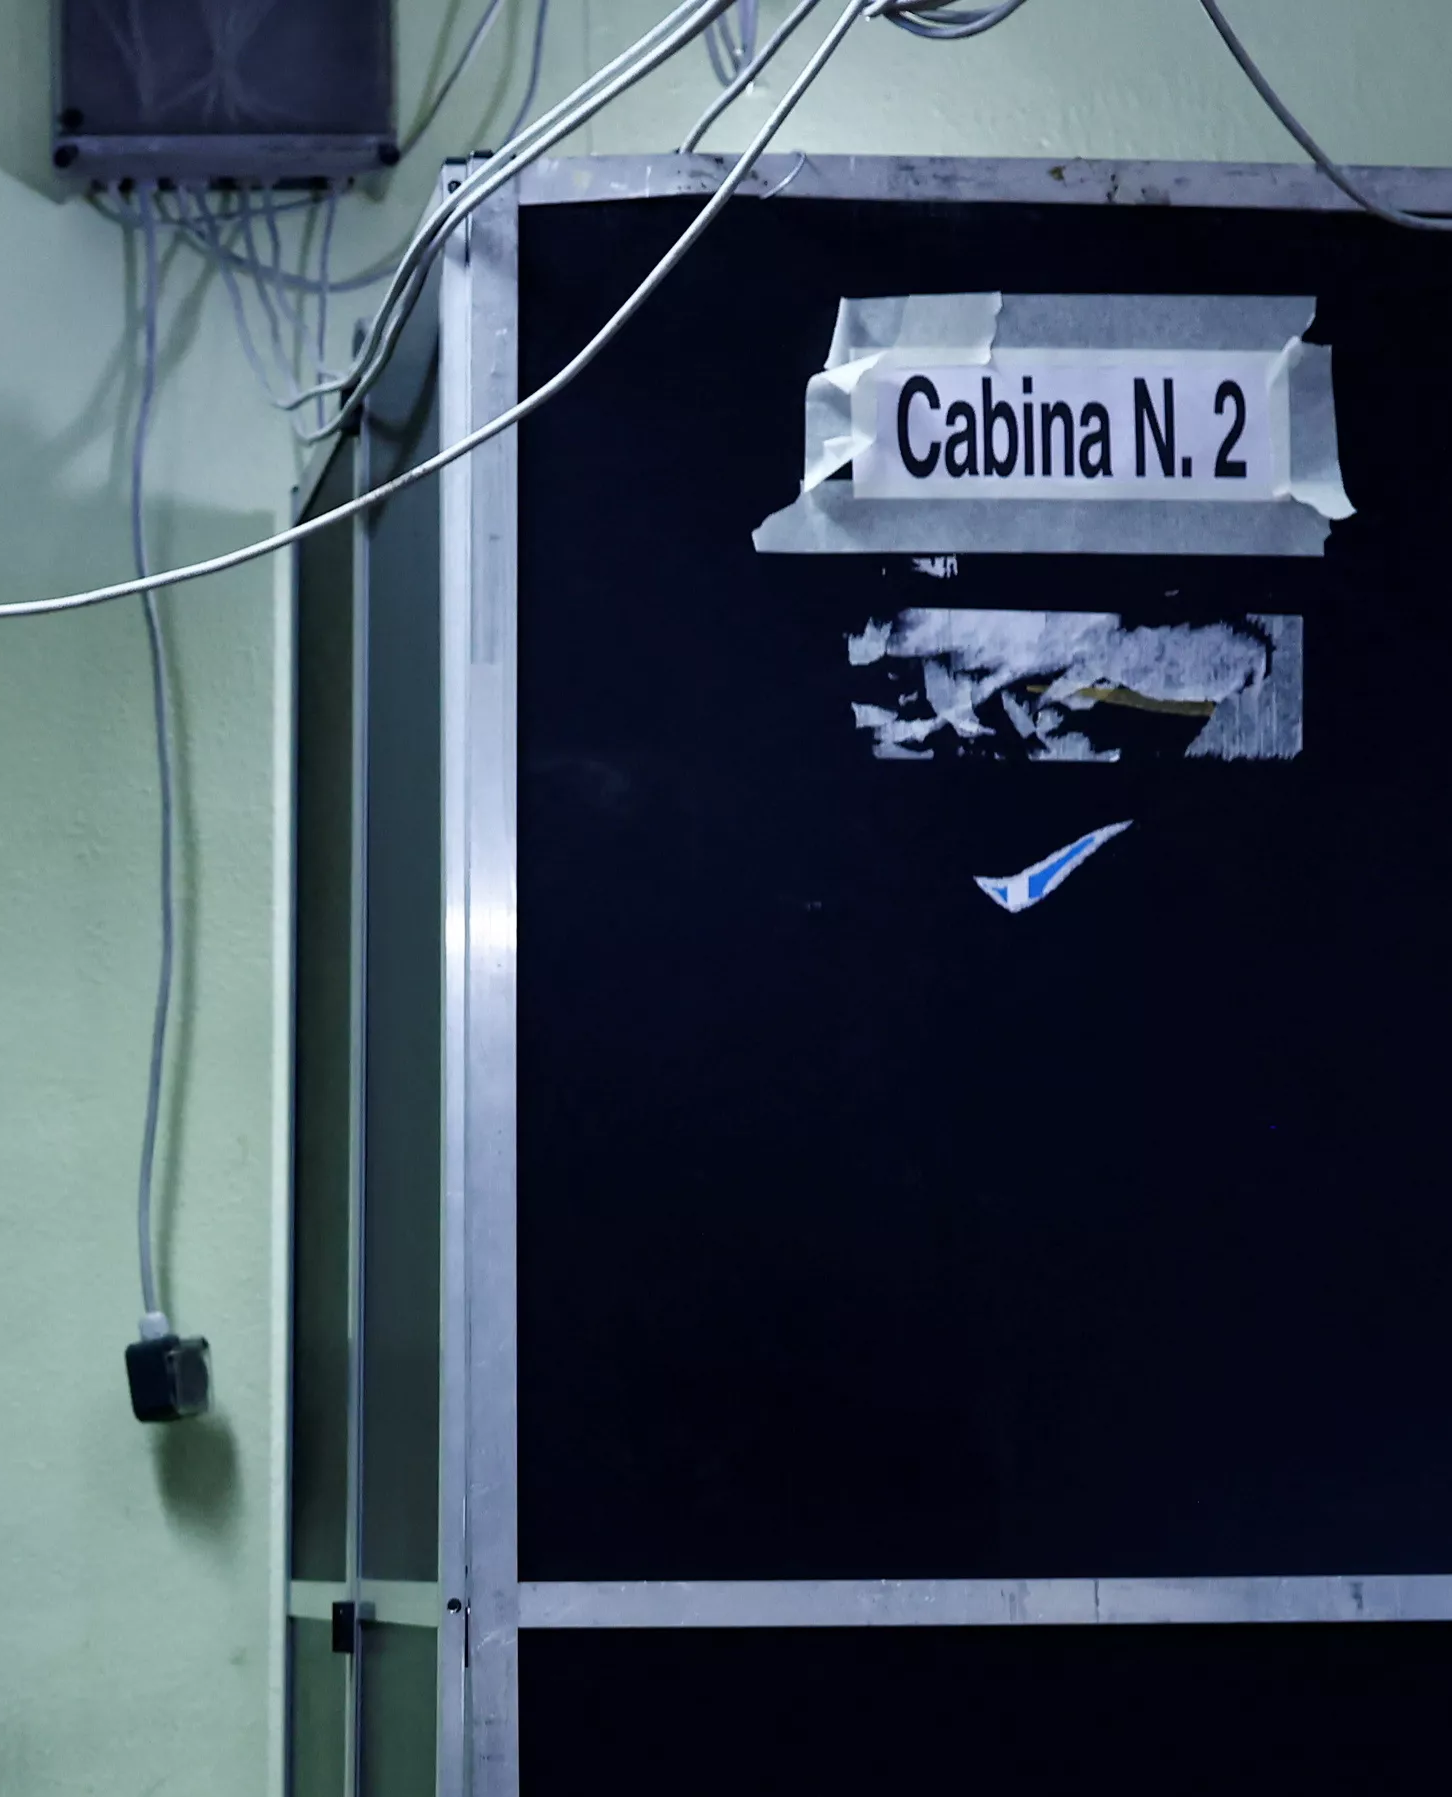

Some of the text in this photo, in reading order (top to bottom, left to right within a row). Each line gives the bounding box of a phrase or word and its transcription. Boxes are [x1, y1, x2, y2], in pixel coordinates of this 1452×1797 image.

[896, 374, 1248, 479] Cabina N. 2
